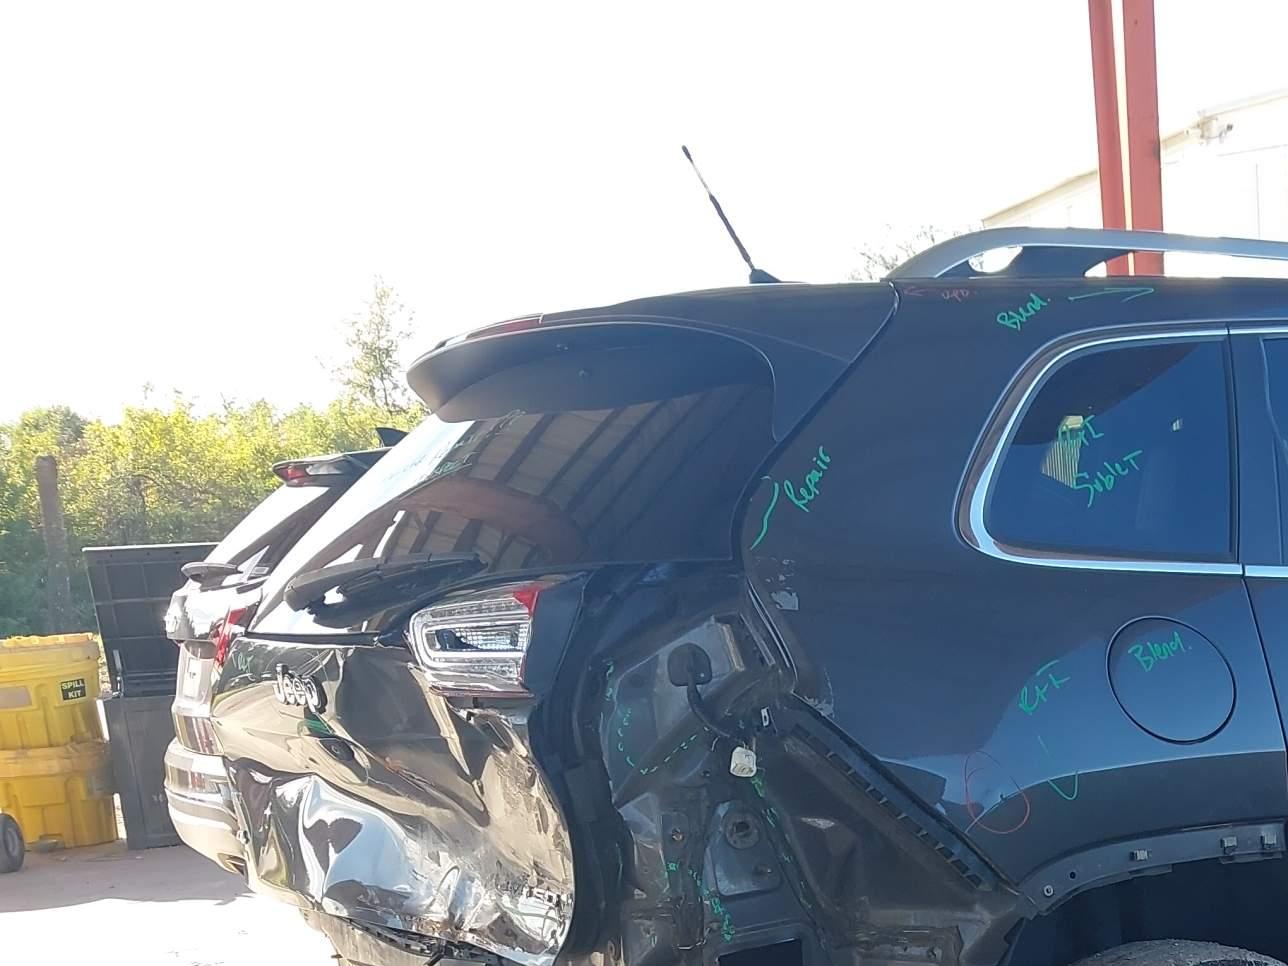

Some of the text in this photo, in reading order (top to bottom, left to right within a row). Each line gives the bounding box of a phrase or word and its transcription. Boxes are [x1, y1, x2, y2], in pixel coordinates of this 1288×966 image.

[62, 680, 84, 690] SPILL
[275, 663, 321, 713] Jeep
[68, 690, 81, 699] KIT
